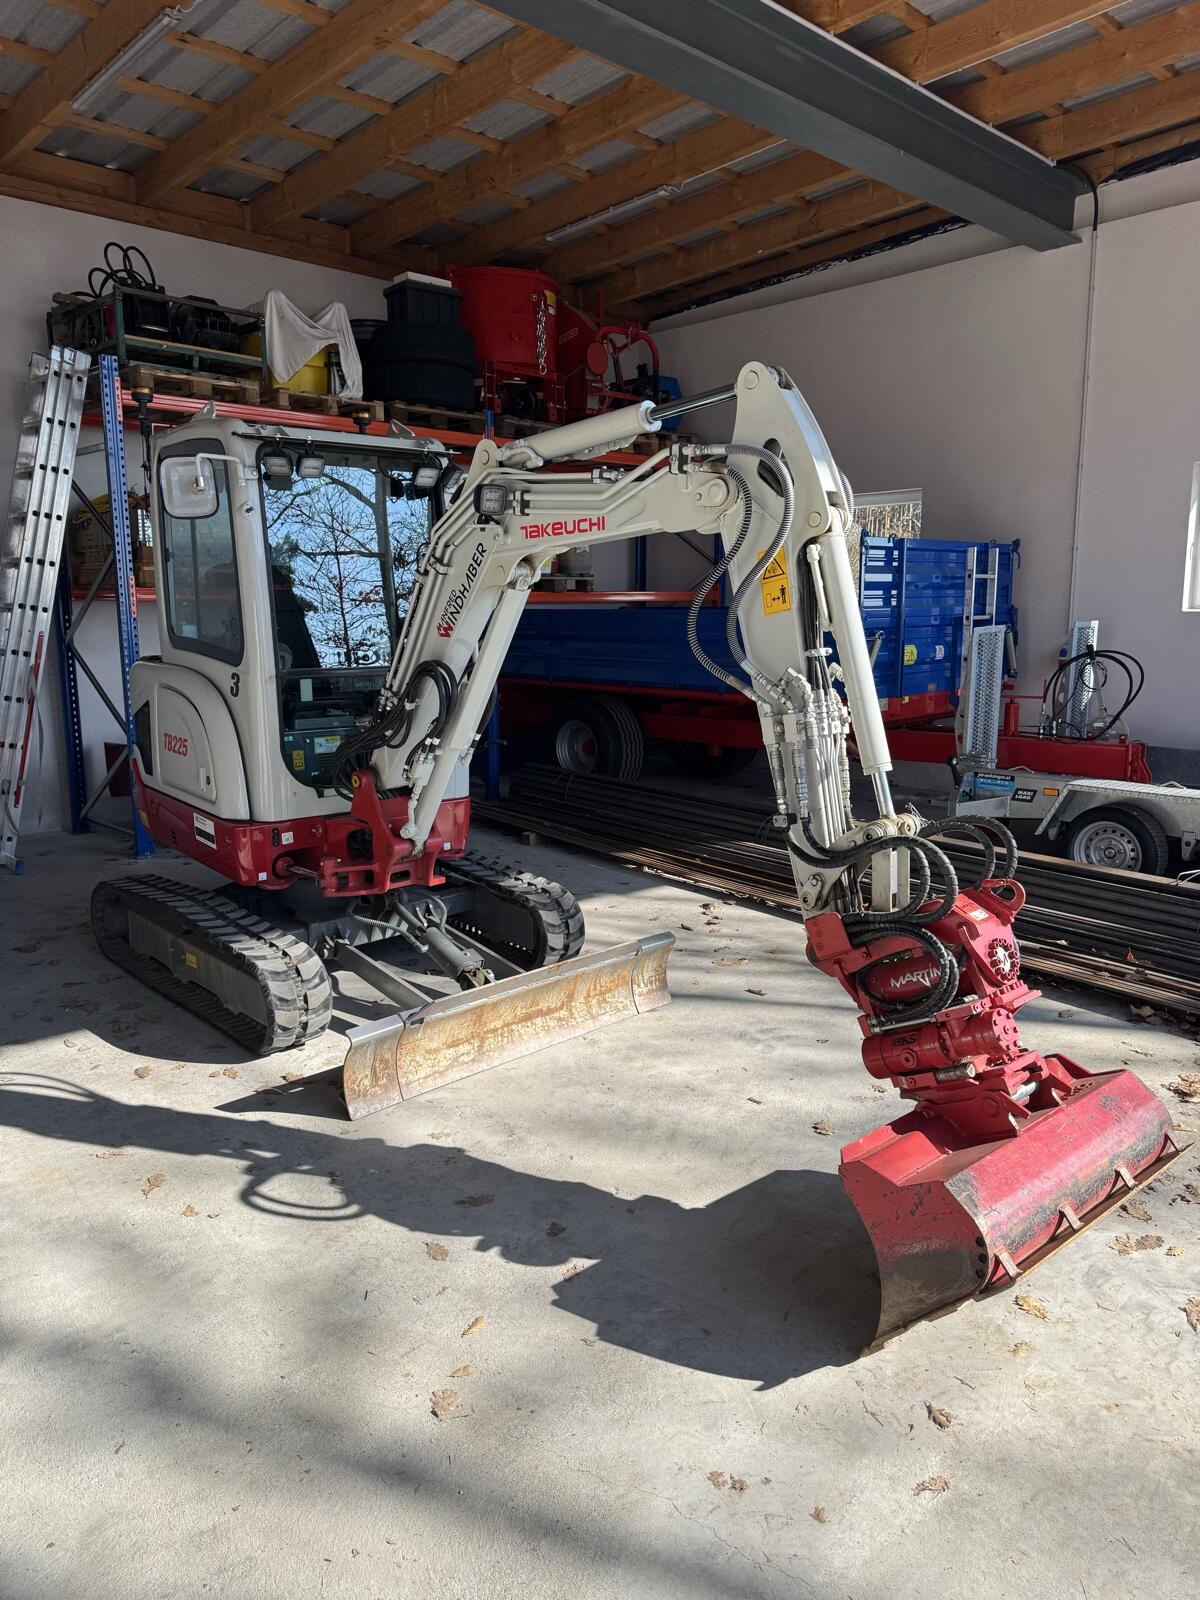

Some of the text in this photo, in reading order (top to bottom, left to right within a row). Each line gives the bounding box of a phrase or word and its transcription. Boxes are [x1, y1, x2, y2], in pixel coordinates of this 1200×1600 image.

[439, 543, 487, 638] WINDHABER
[437, 589, 457, 632] MANFRED
[230, 672, 240, 698] 3
[163, 733, 188, 757] TB225
[890, 965, 941, 989] MARTIN
